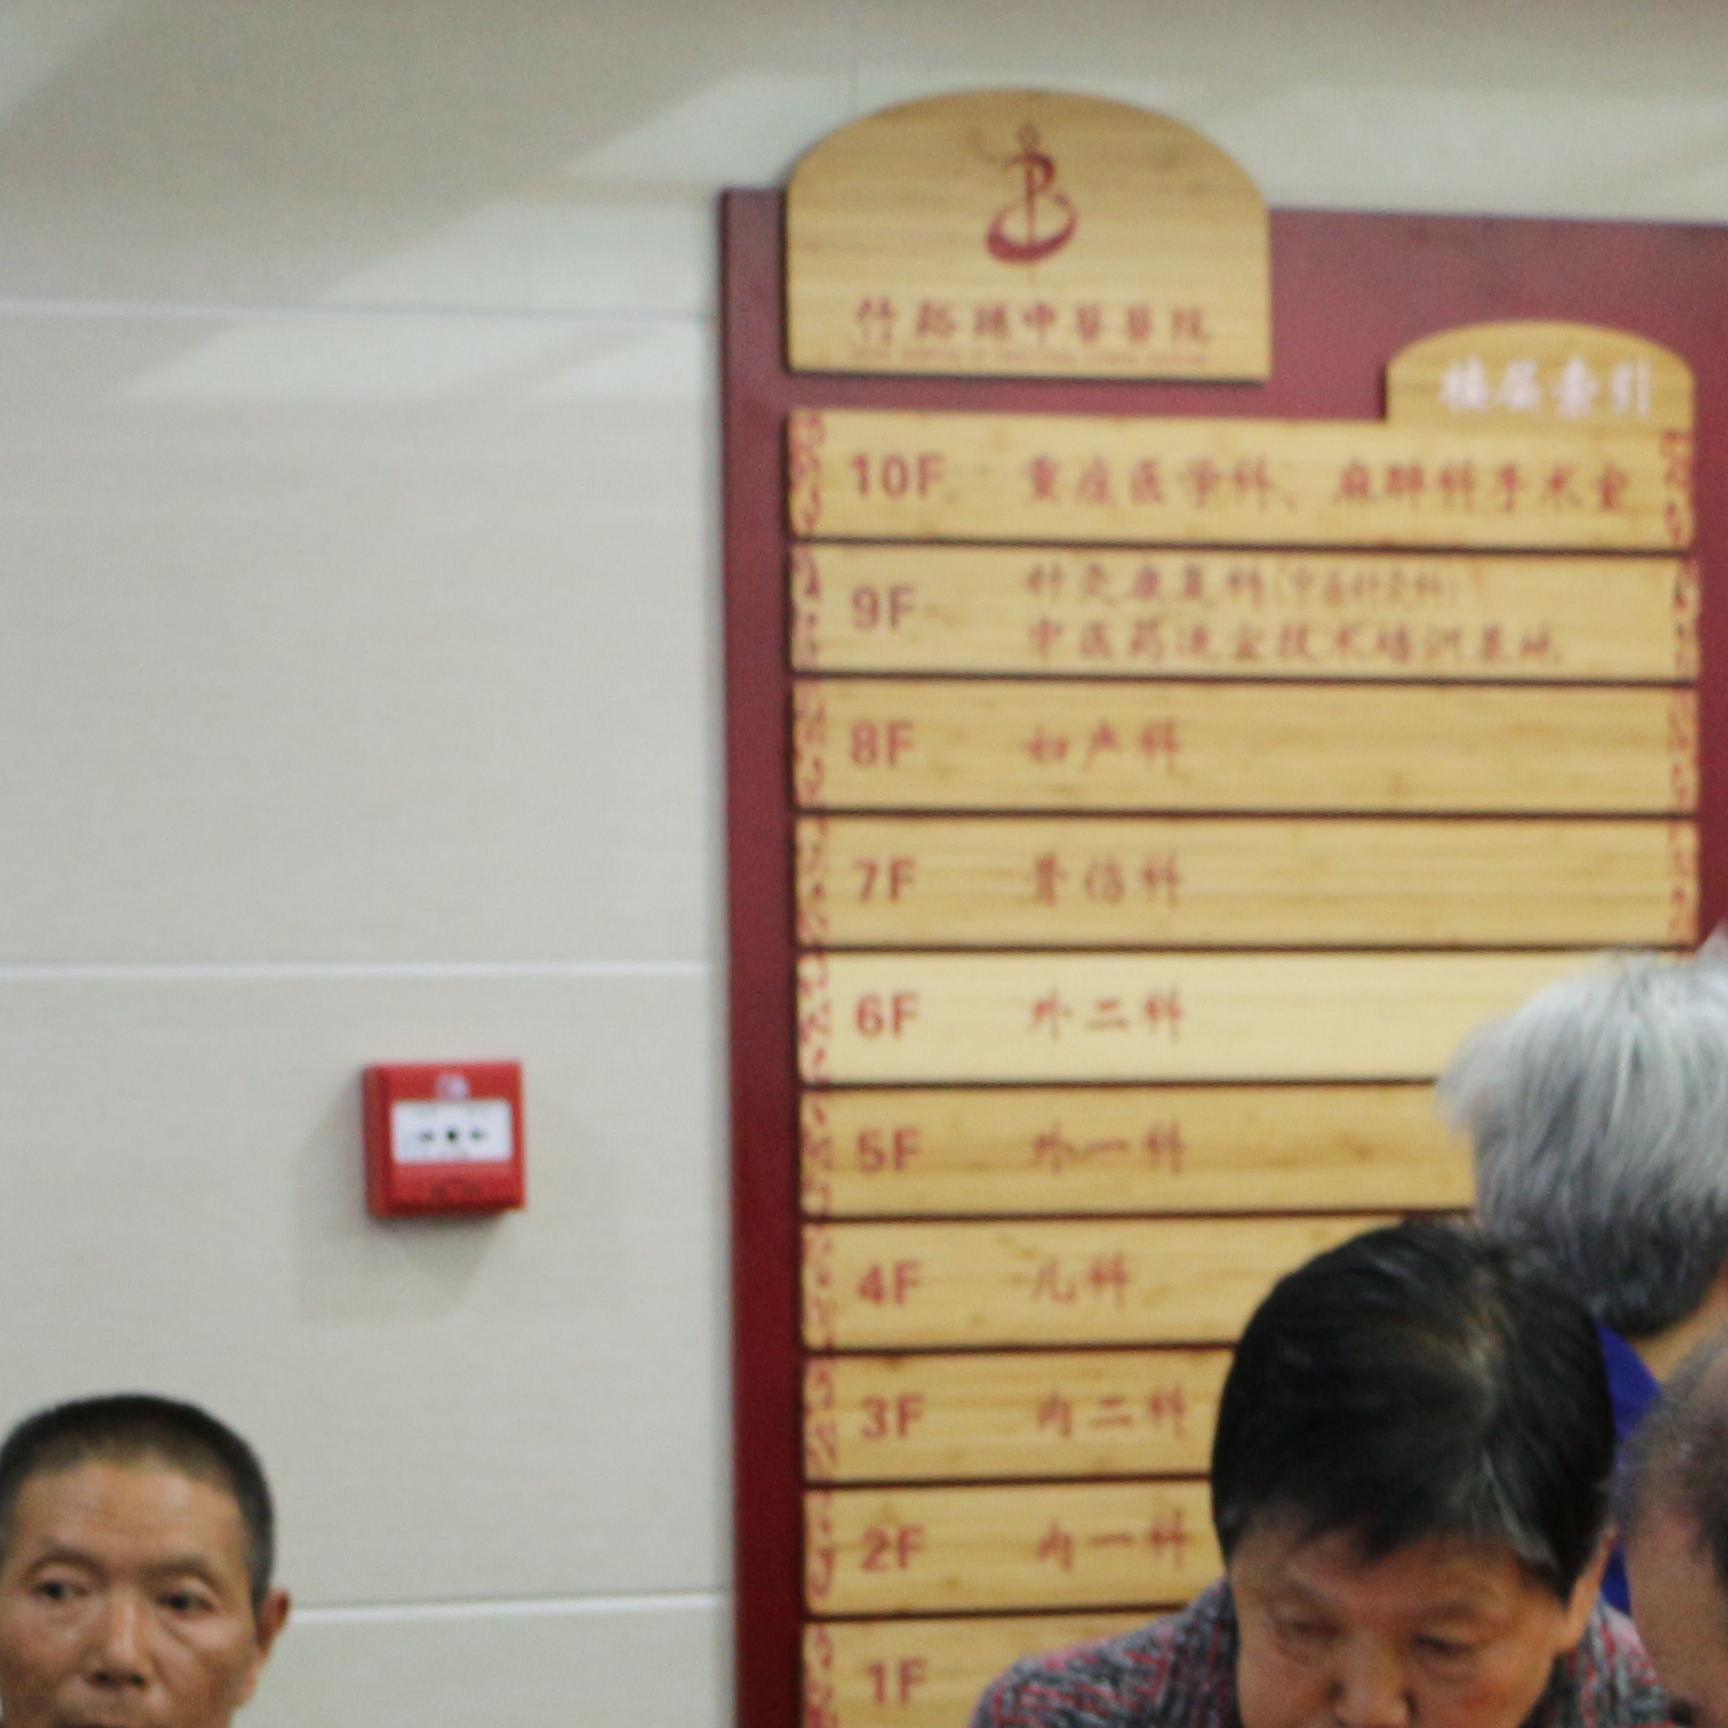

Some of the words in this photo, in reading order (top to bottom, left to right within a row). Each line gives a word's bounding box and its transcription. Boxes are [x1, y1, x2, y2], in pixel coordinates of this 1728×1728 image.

[850, 453, 944, 503] 10F
[849, 582, 916, 632] 9F
[848, 719, 915, 768] 8F
[1021, 718, 1182, 772] 妇产科
[851, 855, 917, 905] 7F
[853, 992, 918, 1038] 6F
[1029, 988, 1184, 1042] 外二科
[855, 1128, 920, 1175] 5F
[1030, 1124, 1186, 1174] 外一科
[855, 1260, 921, 1308] 4F
[1033, 1253, 1130, 1306] 儿科
[860, 1392, 925, 1441] 3F
[1035, 1385, 1188, 1440] 内二科
[861, 1525, 924, 1573] 2F
[1034, 1512, 1189, 1571] 内一科
[865, 1657, 927, 1708] 1F
